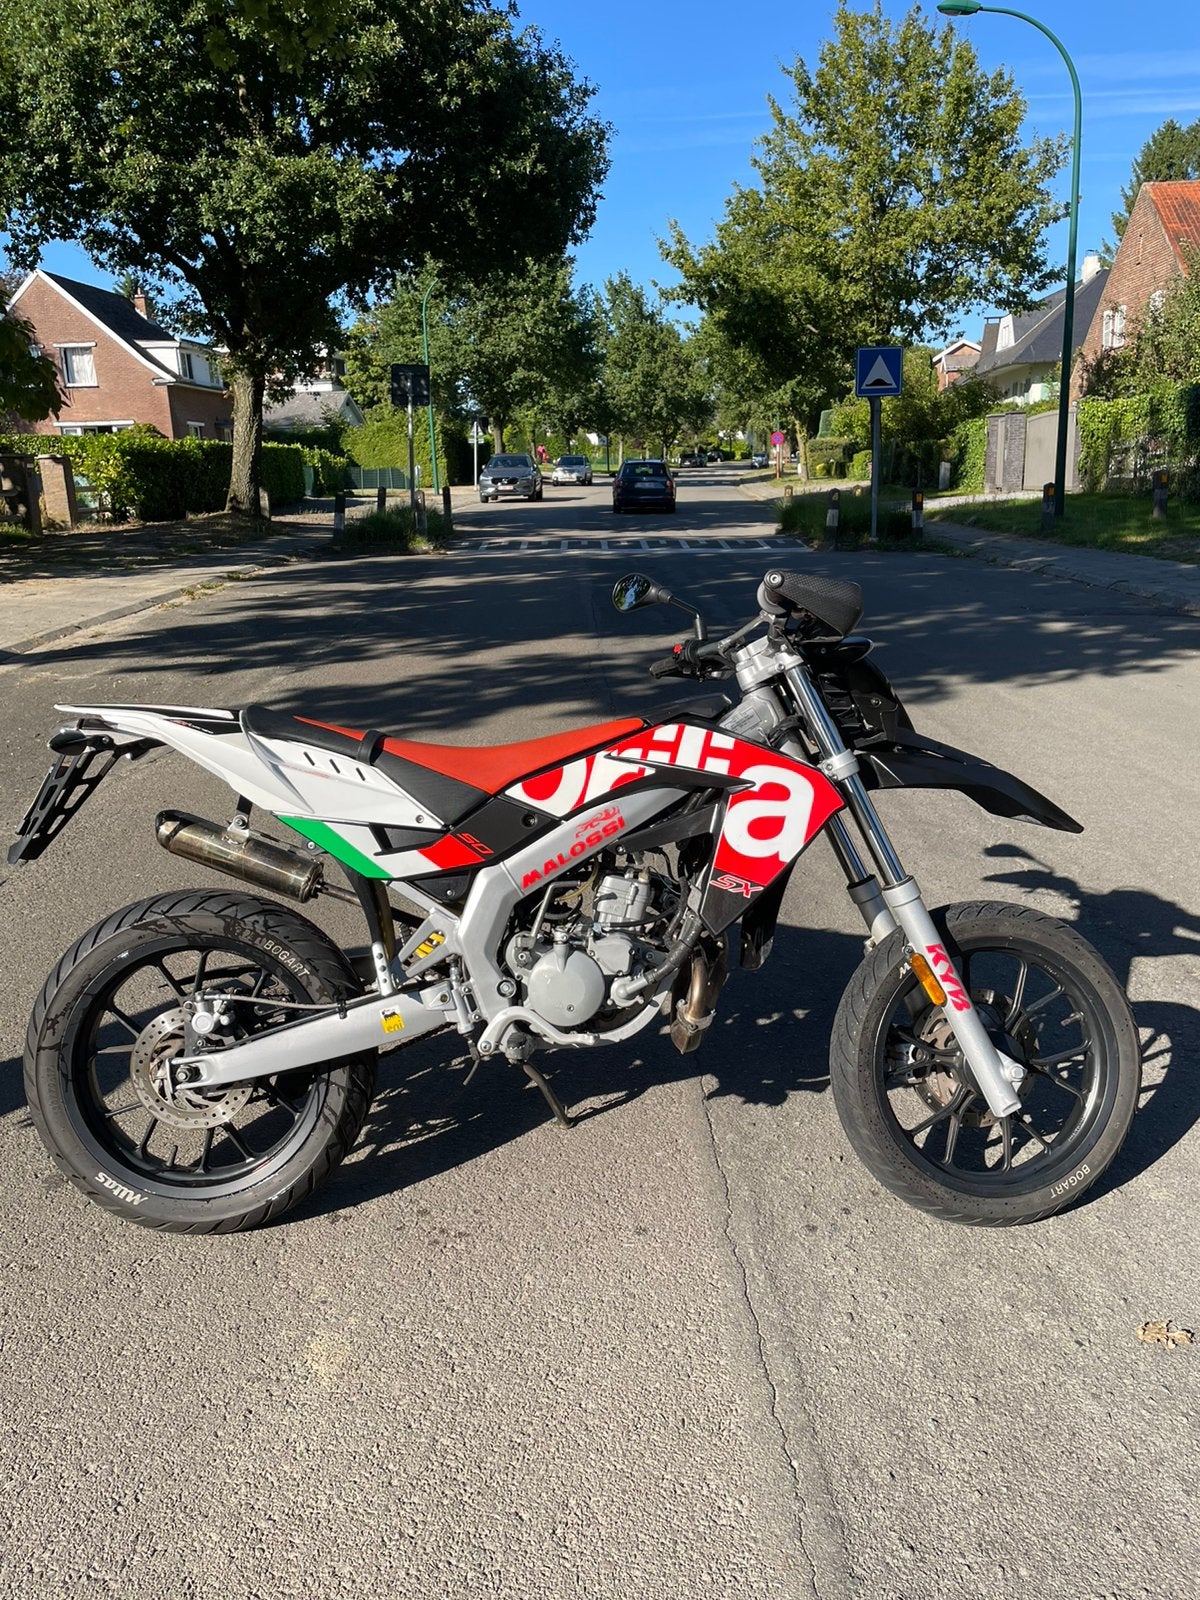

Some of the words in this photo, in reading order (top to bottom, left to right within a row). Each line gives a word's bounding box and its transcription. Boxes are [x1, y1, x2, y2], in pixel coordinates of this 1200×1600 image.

[456, 833, 495, 854] 50
[522, 816, 625, 890] MALOSSI
[710, 875, 764, 898] SX
[263, 940, 310, 977] BOGART
[925, 944, 971, 1012] KYB
[94, 1171, 149, 1206] Mitas
[1050, 1164, 1091, 1199] BOGART
